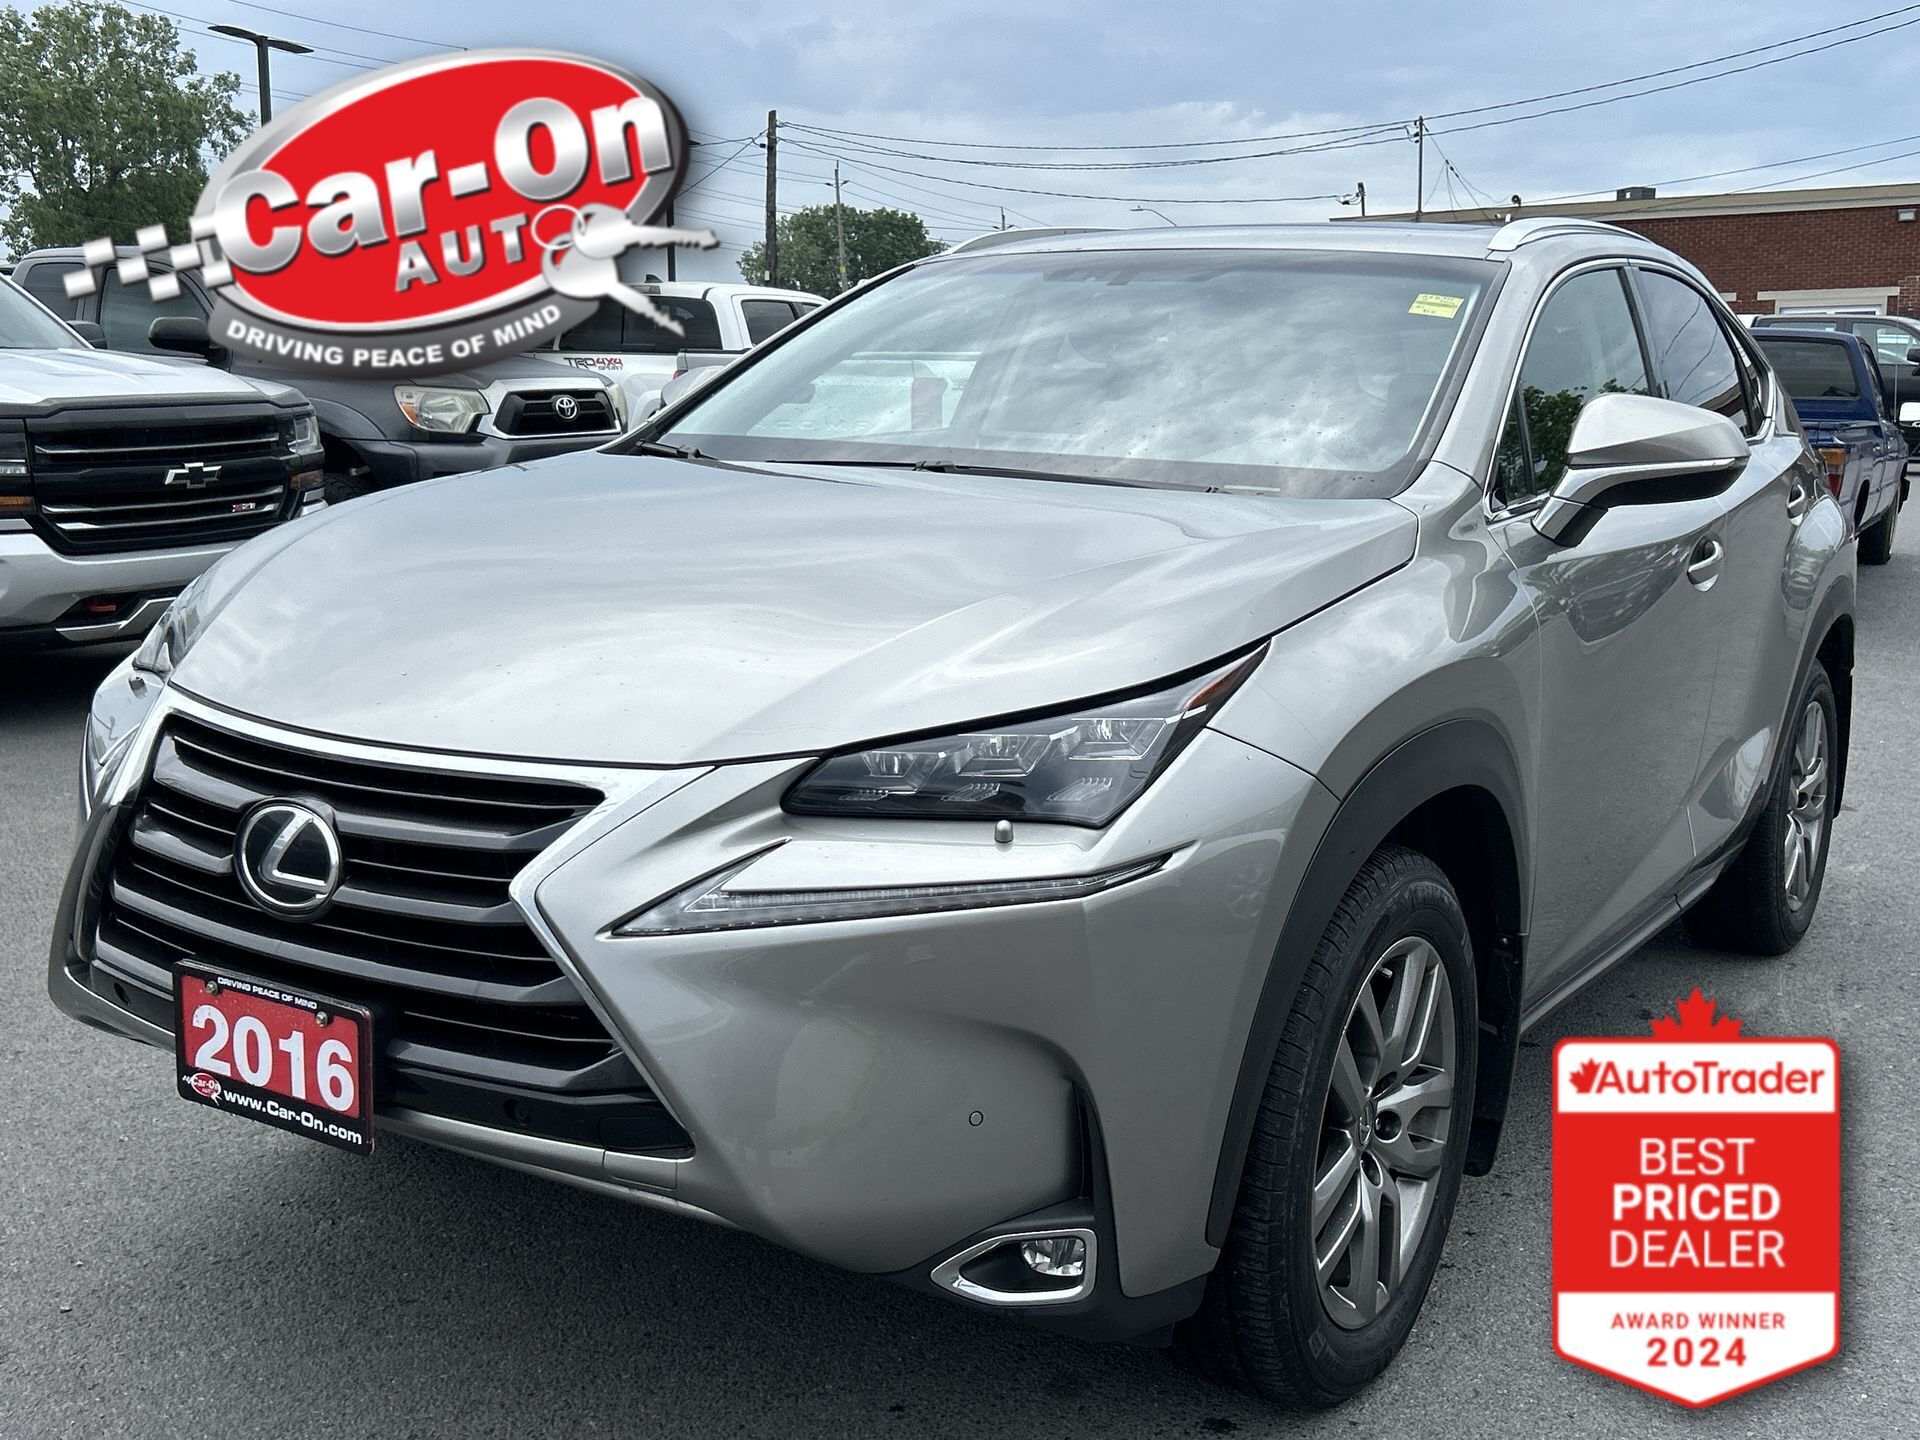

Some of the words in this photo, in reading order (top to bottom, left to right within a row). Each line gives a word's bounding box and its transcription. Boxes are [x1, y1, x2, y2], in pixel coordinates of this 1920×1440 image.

[217, 976, 251, 991] DRIVING
[252, 985, 280, 999] PEACE
[281, 993, 293, 1002] OF
[294, 996, 318, 1010] MIND
[192, 1004, 355, 1112] 2016
[223, 1089, 362, 1145] www.Car-On.com
